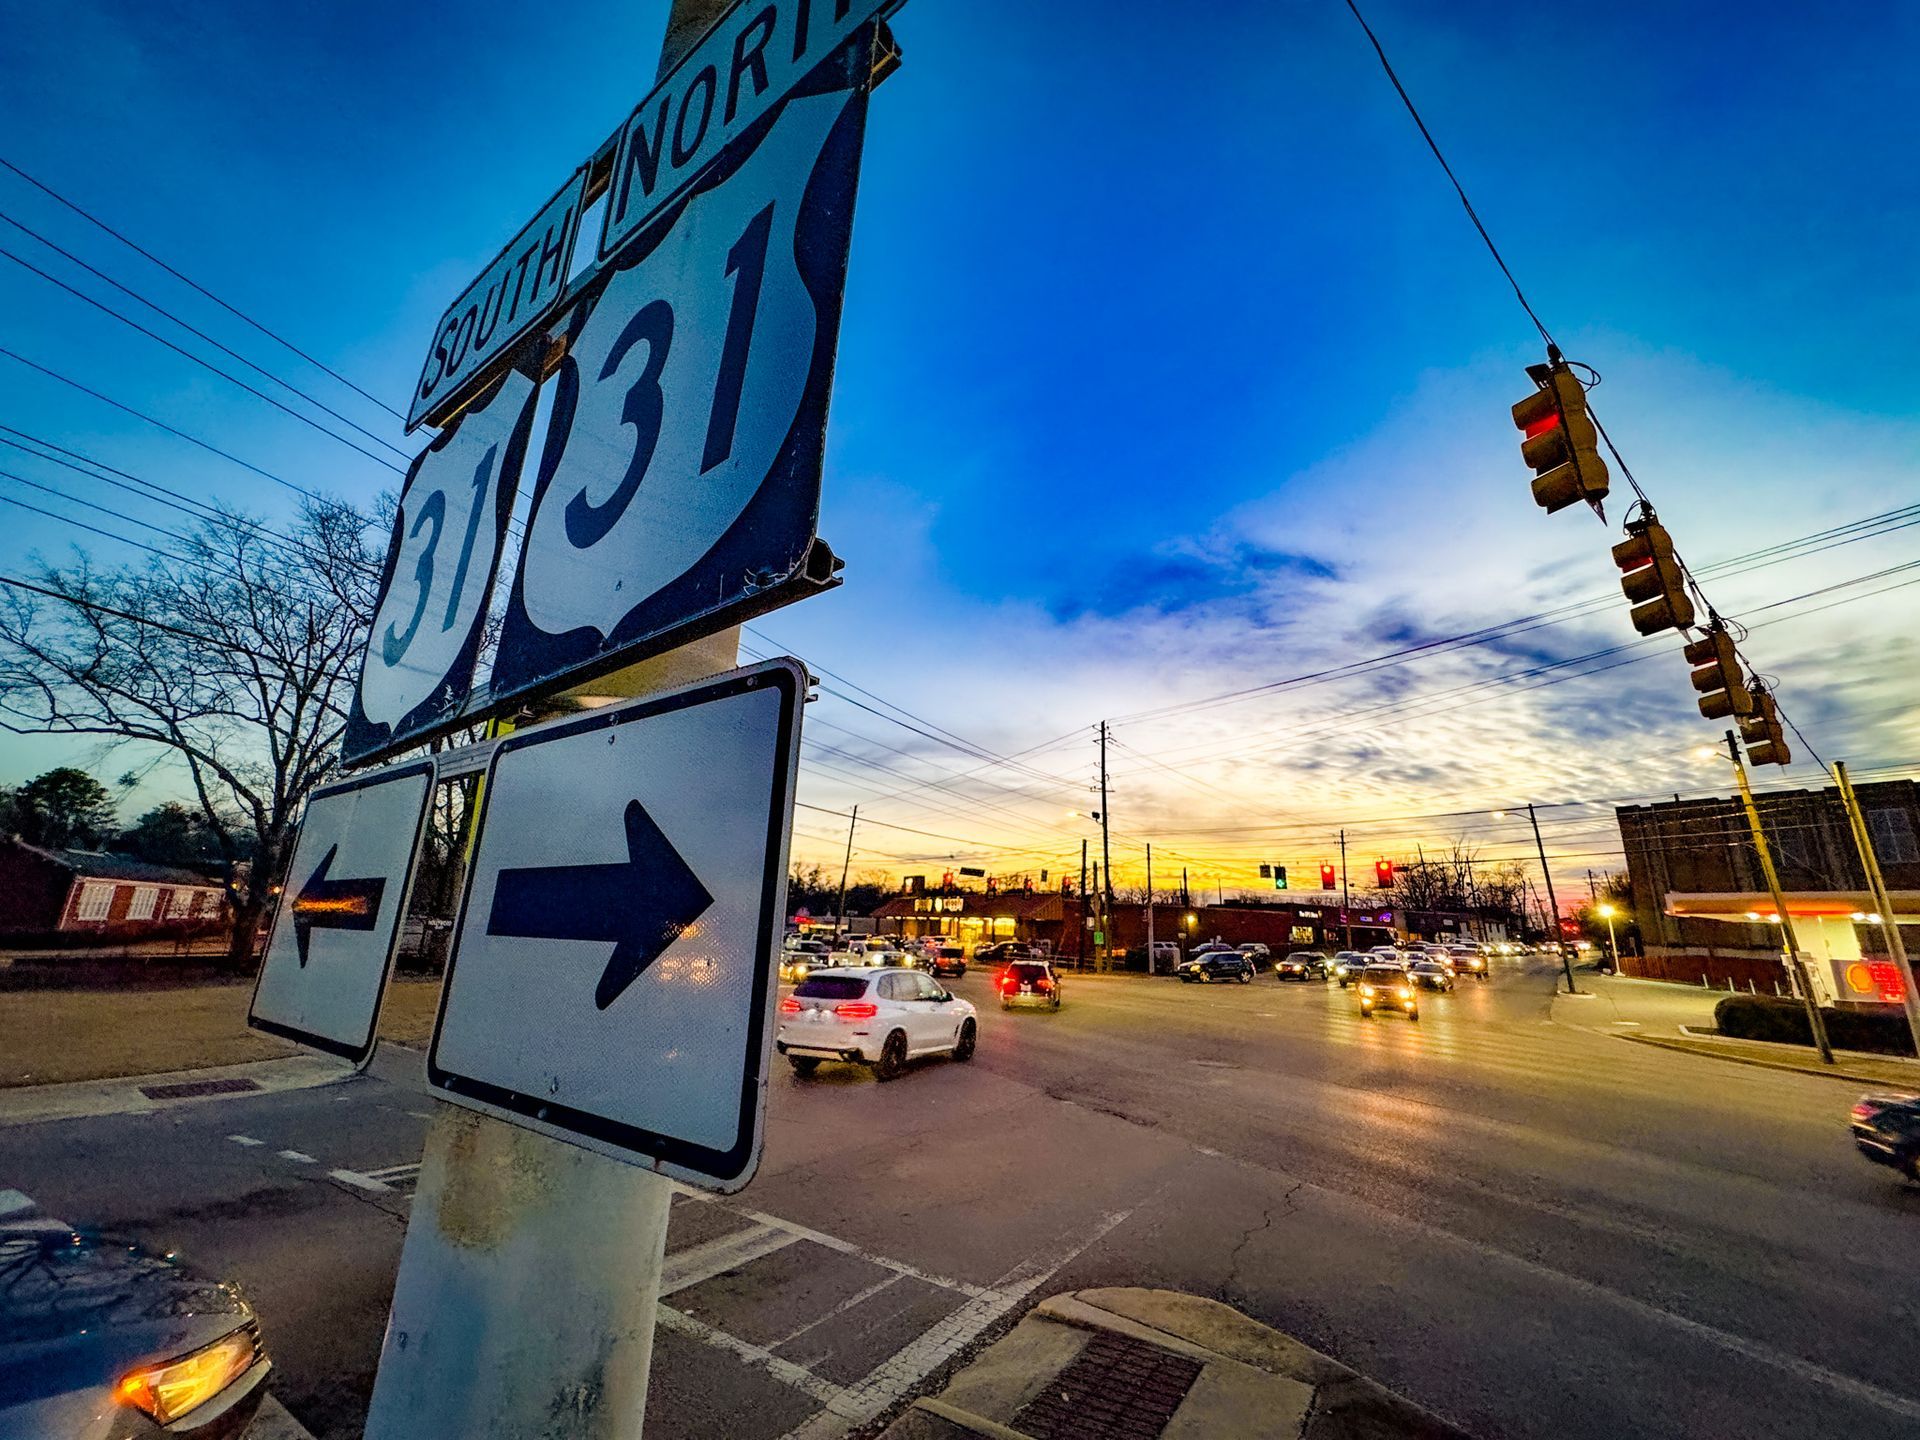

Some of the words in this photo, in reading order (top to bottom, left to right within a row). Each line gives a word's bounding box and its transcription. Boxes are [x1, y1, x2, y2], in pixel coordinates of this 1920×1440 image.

[421, 205, 574, 400] SOUTH
[565, 200, 776, 549] 31
[383, 443, 498, 668] 31
